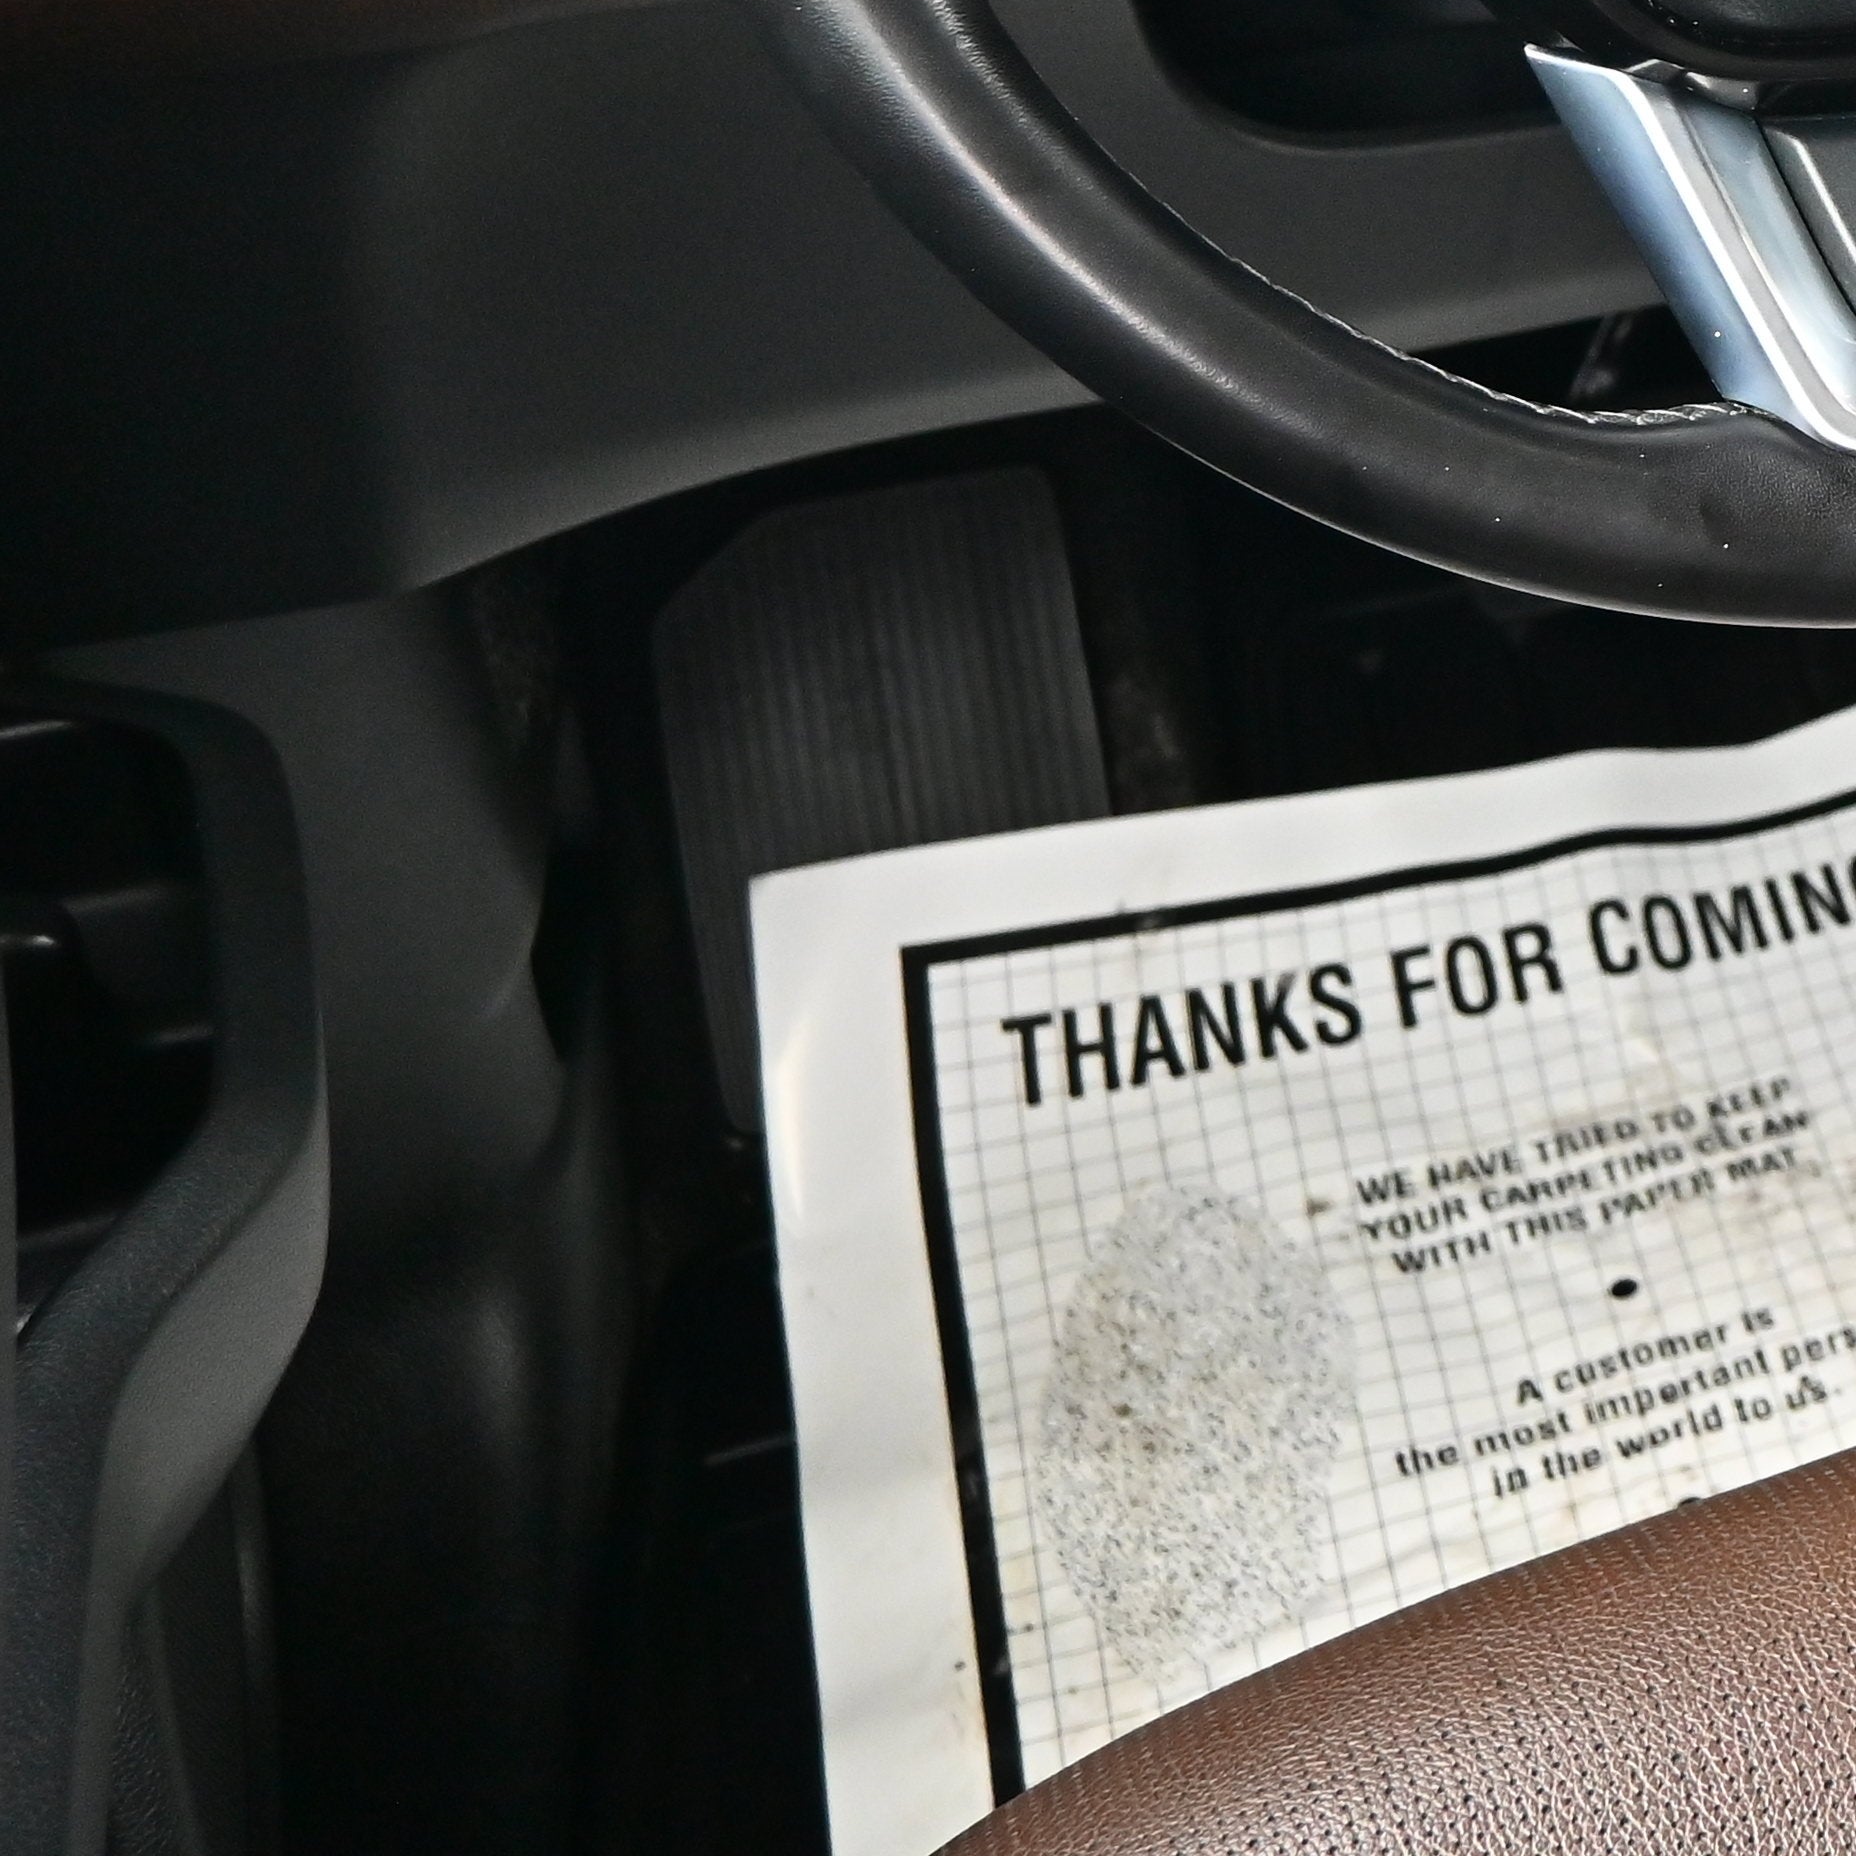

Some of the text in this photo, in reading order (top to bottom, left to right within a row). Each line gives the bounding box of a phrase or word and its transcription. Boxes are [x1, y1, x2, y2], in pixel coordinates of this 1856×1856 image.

[1003, 962, 1364, 1107] THANKS
[1391, 921, 1566, 1028] FOR
[1356, 1076, 1791, 1206] WE HAVE TRIED TO KEEP
[1358, 1109, 1812, 1240] YOUR CARPETING CLEAN
[1390, 1230, 1491, 1274] WITH
[1504, 1206, 1589, 1246] THIS
[1599, 1166, 1716, 1225] PAPER
[1395, 1445, 1459, 1477] the
[1473, 1408, 1572, 1457] most
[1584, 1348, 1770, 1426] important
[1516, 1306, 1775, 1408] A customer is
[1490, 1464, 1530, 1501] in
[1541, 1446, 1602, 1482] the
[1616, 1402, 1724, 1460] world
[1733, 1395, 1772, 1424] to
